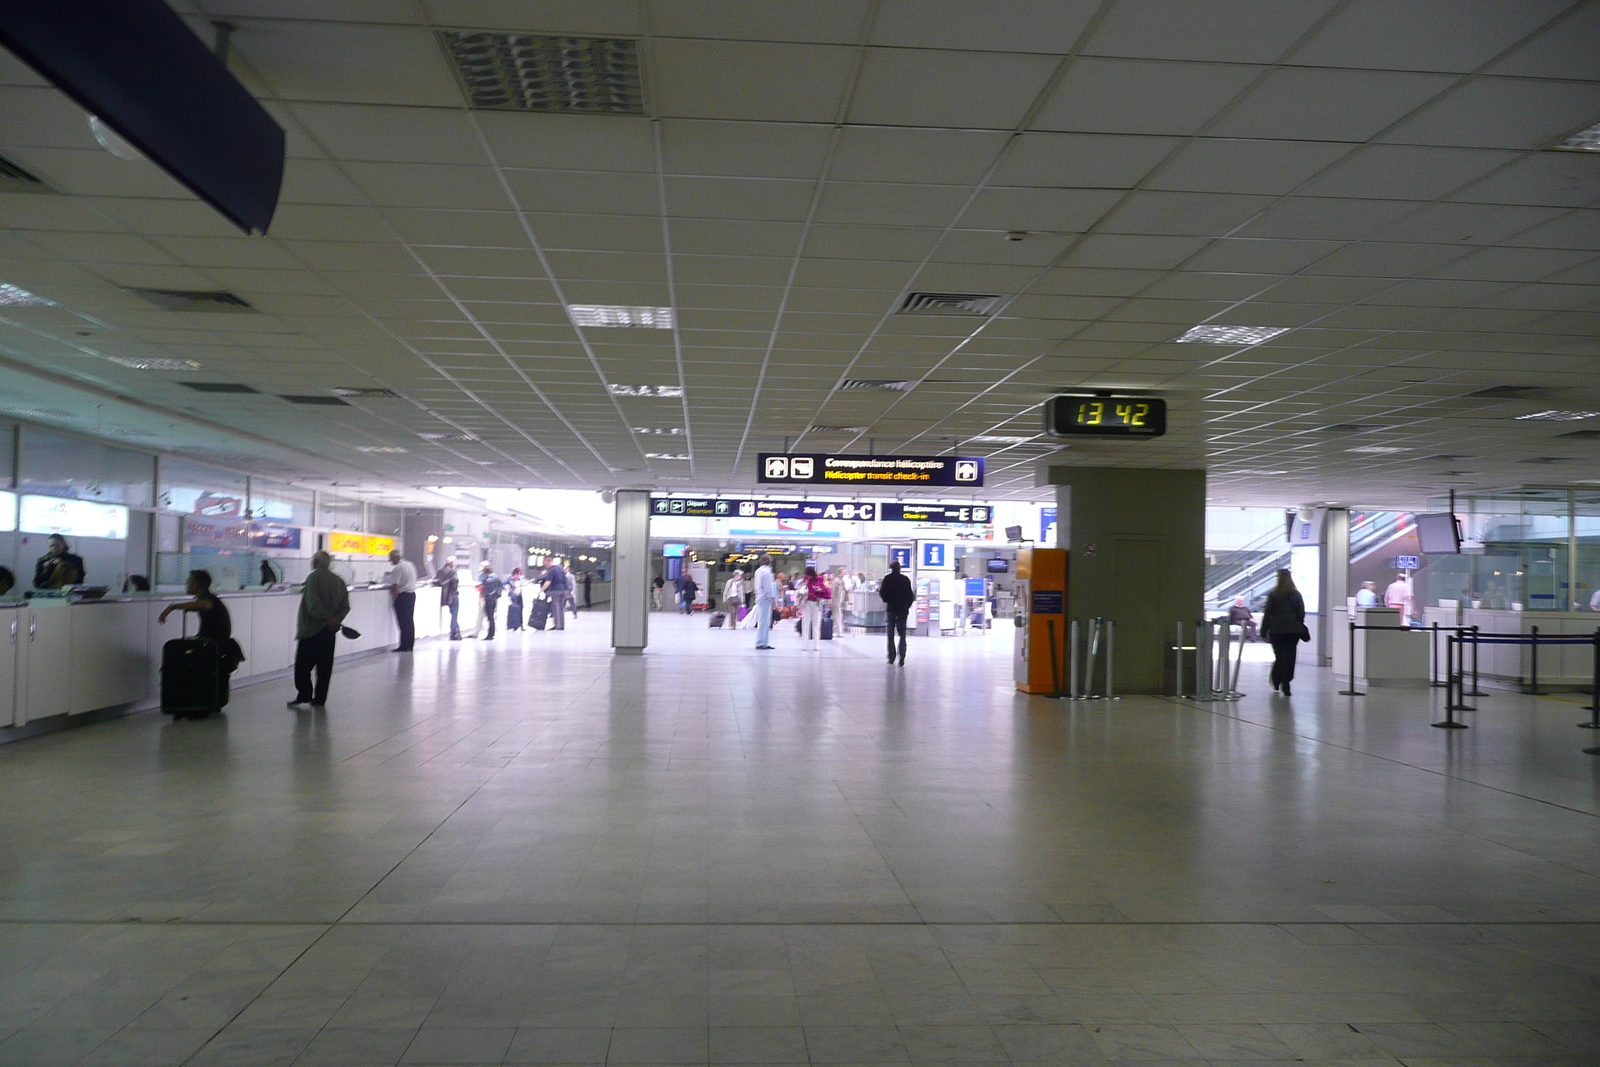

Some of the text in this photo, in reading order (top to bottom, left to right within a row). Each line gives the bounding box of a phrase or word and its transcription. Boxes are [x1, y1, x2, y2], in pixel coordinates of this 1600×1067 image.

[1077, 402, 1150, 426] 13 42
[825, 458, 895, 469] Correspondance
[866, 471, 893, 480] transit
[894, 471, 930, 481] check-in
[958, 508, 970, 521] E
